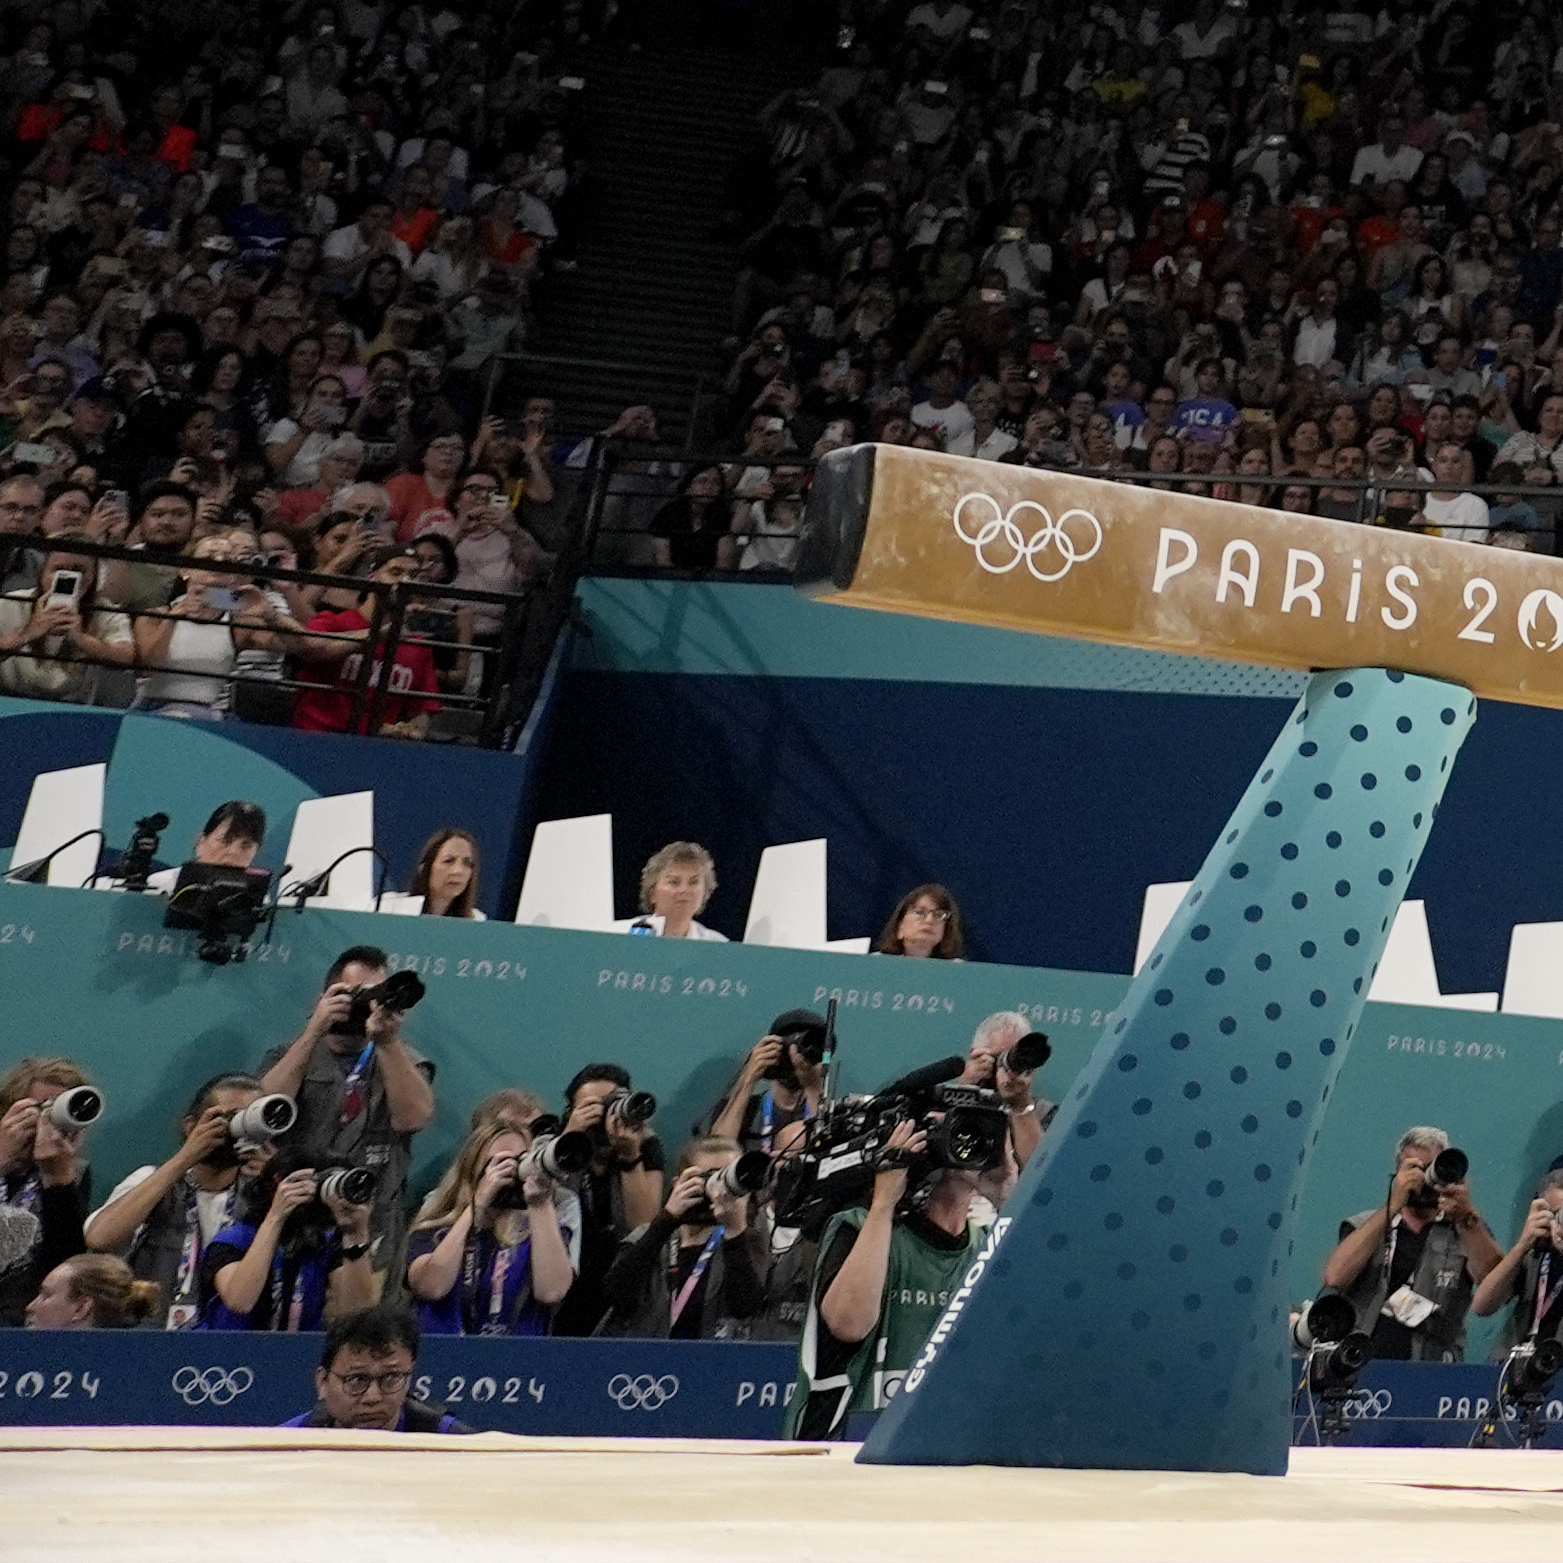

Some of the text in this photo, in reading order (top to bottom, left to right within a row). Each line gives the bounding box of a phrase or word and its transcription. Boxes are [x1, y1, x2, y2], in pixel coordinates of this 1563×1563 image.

[456, 958, 528, 980] 2024
[681, 976, 748, 998] 2024
[891, 992, 956, 1015] 2024
[1454, 1041, 1506, 1060] 2024
[904, 1217, 1013, 1393] GYMNOVA
[446, 1376, 546, 1403] 2024
[1438, 1396, 1517, 1421] PARS
